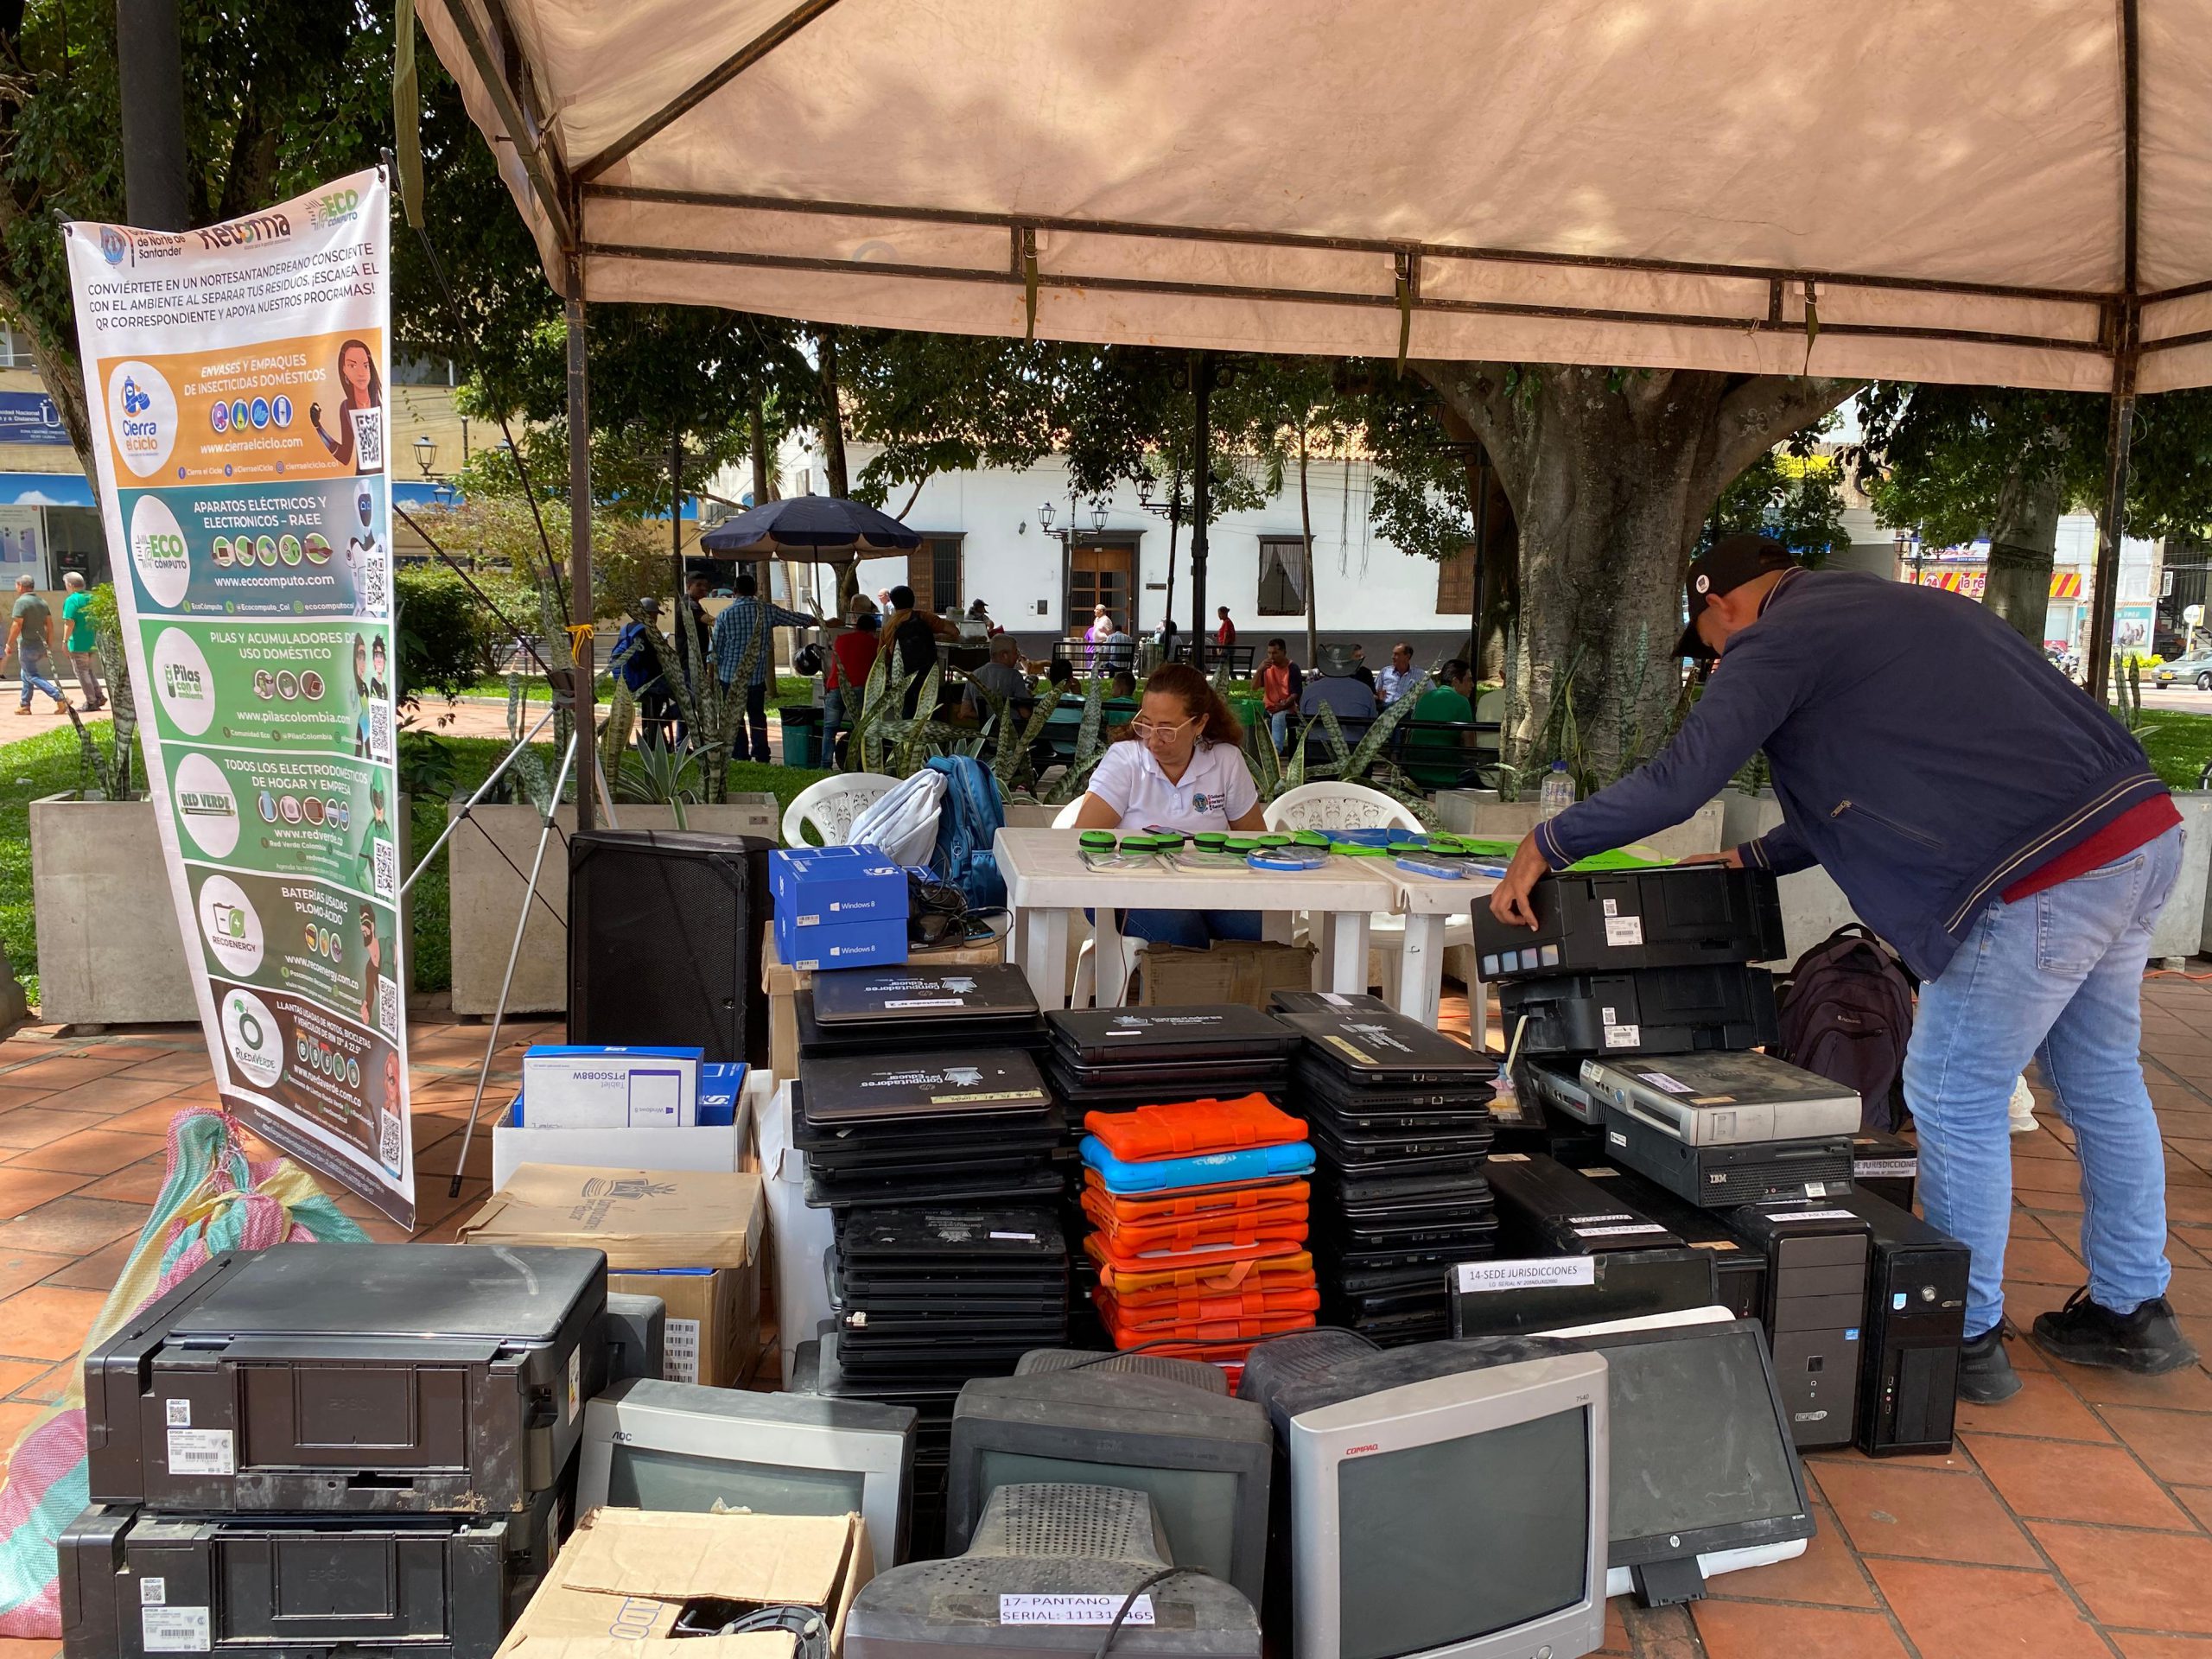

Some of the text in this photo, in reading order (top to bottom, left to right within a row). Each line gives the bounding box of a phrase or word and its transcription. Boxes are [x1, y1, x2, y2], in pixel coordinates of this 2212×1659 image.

[325, 189, 358, 218] ECO
[138, 236, 148, 246] de
[149, 236, 173, 245] Norte
[138, 247, 181, 259] Santander
[88, 243, 373, 296] CONVIÉRTETE EN UN NORTESANTANDEREANO CONSCIENTE
[89, 301, 110, 313] CON
[112, 299, 127, 311] EL
[130, 296, 183, 310] AMBIENTE
[186, 295, 200, 305] AL
[202, 289, 245, 304] SEPARAR
[248, 286, 263, 297] TUS
[362, 263, 378, 276] EL
[96, 283, 374, 330] QR CORRESPONDIENTE Y APOYA NUESTROS PROGRAMAS!
[201, 354, 306, 377] ENVASES Y EMPAQUES
[184, 369, 326, 396] DE INSECTICIDAS DOMÉSTICOS
[123, 420, 156, 437] Cierra
[127, 437, 157, 450] el ciclo
[200, 437, 302, 454] www.cierraelciclo.com
[194, 496, 326, 513] APARATOS ELÉCTRICOS Y
[204, 513, 322, 529] ELECTRONICOS RAEE
[149, 535, 183, 558] ECO
[154, 558, 187, 569] CÓMPUTO
[215, 575, 334, 588] www.ecocomputo.com
[1961, 576, 1971, 588] la
[211, 632, 356, 644] PILAS Y ACUMULADORES DE
[239, 646, 332, 659] USO DOMÉSTICO
[174, 664, 200, 683] Pilas
[176, 681, 202, 692] con el
[237, 710, 351, 724] www.pilascolombia.com
[225, 759, 368, 784] TODOS LOS ELECTRODOMÉSTICOS
[252, 777, 351, 796] DE HOGAR Y EMPRESA
[181, 793, 230, 809] RED VERDE
[274, 830, 343, 846] www.redverde.co
[302, 842, 326, 851] Colombia
[282, 887, 347, 912] BATERÍAS USADAS
[295, 902, 342, 925] PLOMO-ÁCIDO
[213, 935, 256, 953] RECOENERGY
[285, 955, 359, 989] www.recoenergy.com.co
[276, 1001, 303, 1016] LLANTAS
[303, 1008, 320, 1023] USADAS
[321, 1016, 327, 1027] DE
[344, 1028, 371, 1049] BICICLETAS
[297, 1016, 321, 1037] VEHÍCULOS
[321, 1027, 328, 1038] DE
[294, 1065, 361, 1107] www.ruedaverde.com.co
[861, 1077, 943, 1087] Computadores
[1710, 1174, 1727, 1184] IBM
[1470, 1265, 1578, 1281] 14-SEDE JURISDICCIONES
[611, 1431, 632, 1441] AOC
[1345, 1444, 1379, 1455] COMPAQ
[1671, 1536, 1679, 1547] hp
[1033, 1597, 1110, 1605] PANTANO
[1002, 1611, 1154, 1620] SERIAL: 11131465
